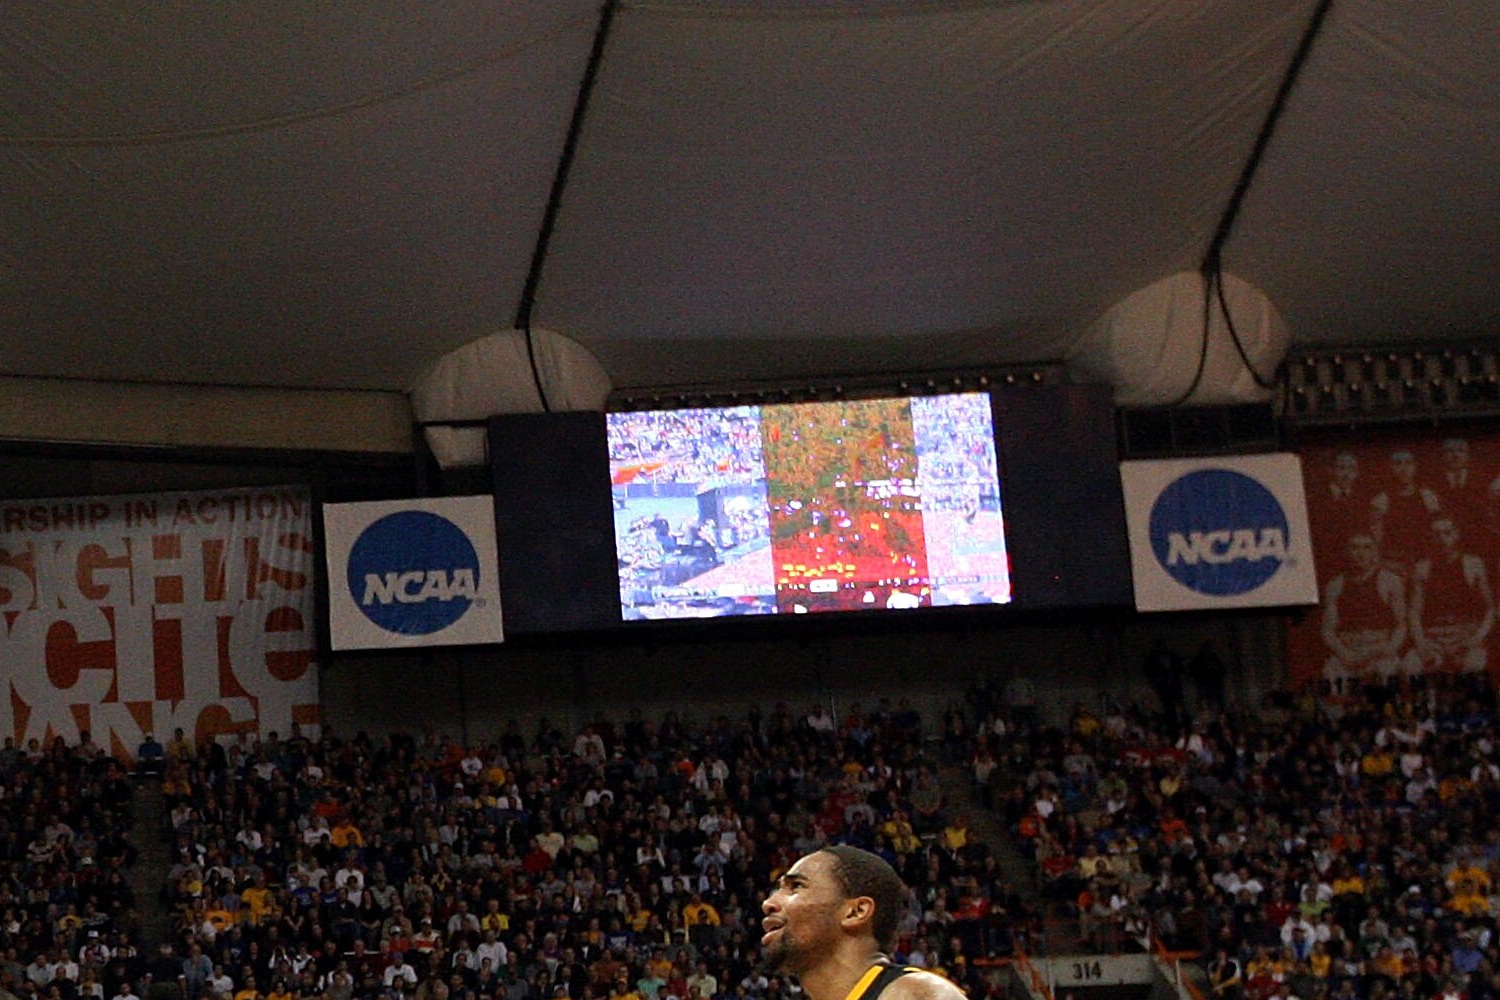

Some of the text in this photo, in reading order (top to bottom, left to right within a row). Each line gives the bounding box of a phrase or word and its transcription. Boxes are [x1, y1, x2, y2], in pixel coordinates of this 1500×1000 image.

[125, 500, 157, 528] IN
[173, 494, 300, 526] ACTION
[1166, 528, 1290, 566] NCAA
[362, 569, 481, 606] NCAA
[1073, 963, 1102, 980] 314
